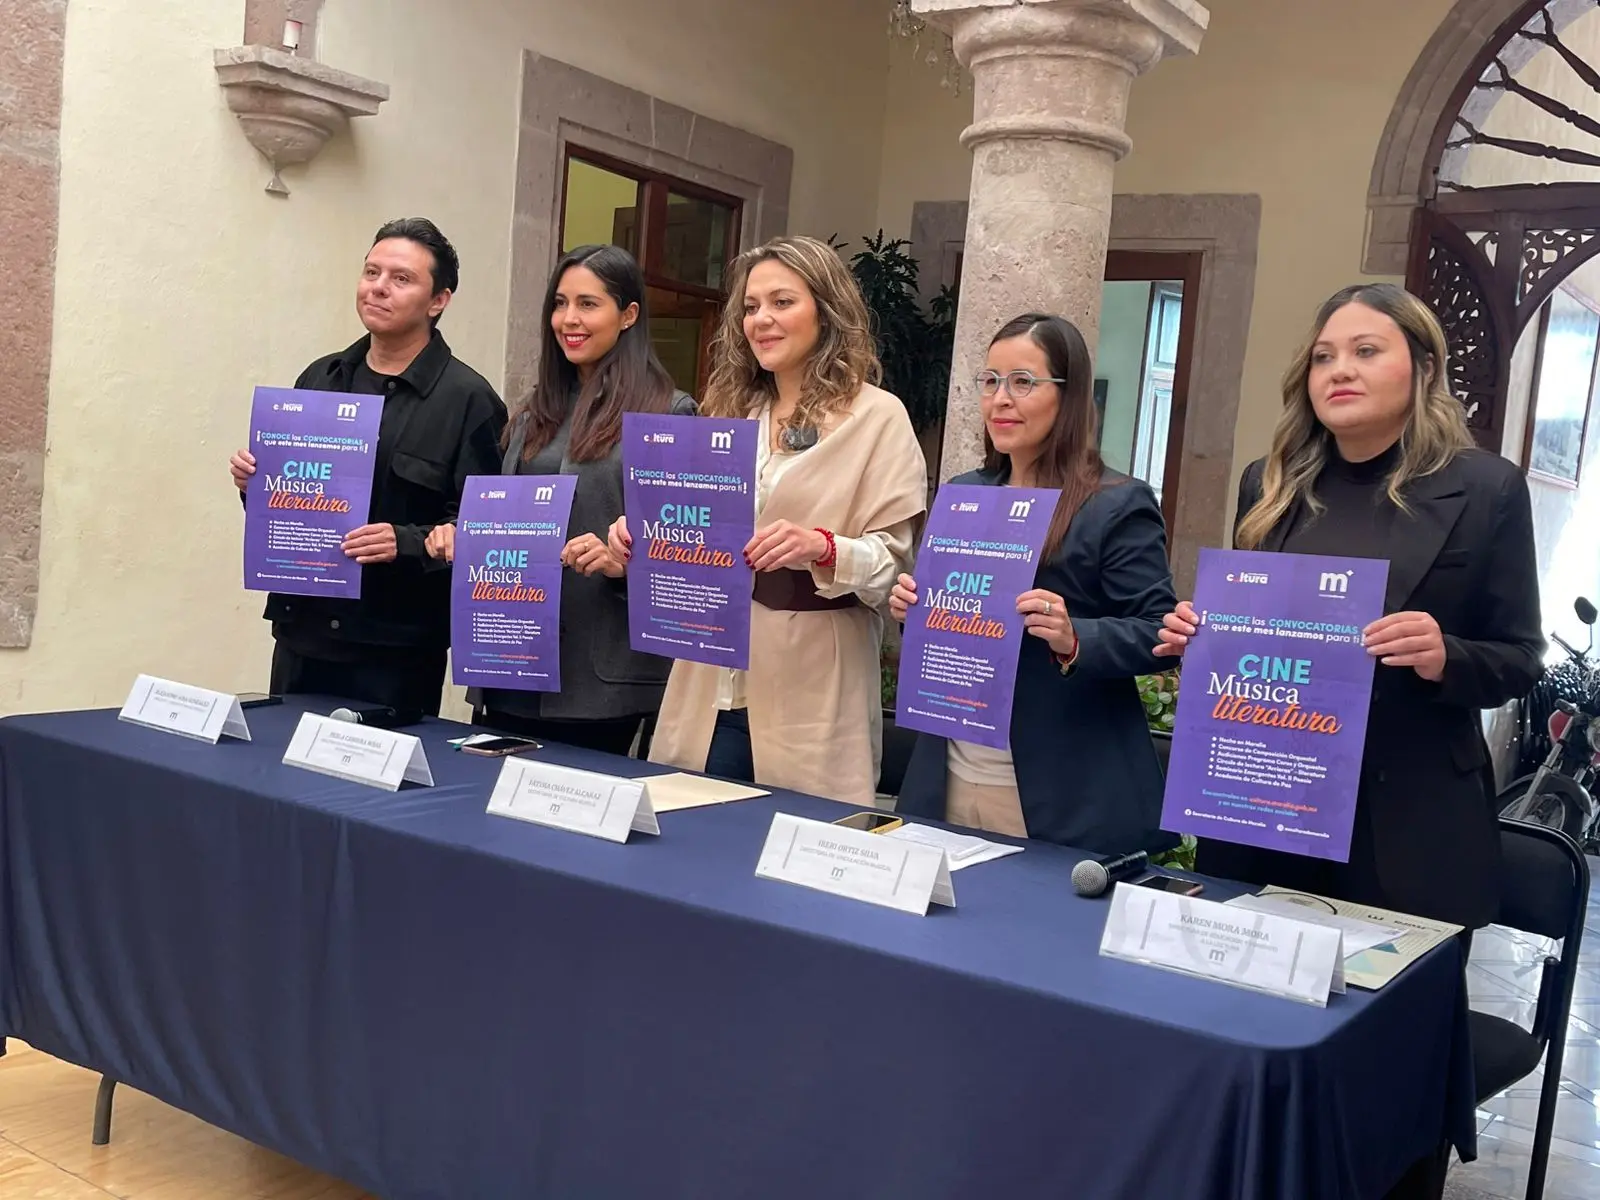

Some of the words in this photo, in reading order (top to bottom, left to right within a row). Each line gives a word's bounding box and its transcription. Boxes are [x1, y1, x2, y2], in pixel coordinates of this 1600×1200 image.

[263, 439, 276, 447] que
[308, 441, 340, 449] lanzamos
[342, 444, 357, 452] para
[303, 435, 363, 445] CONVOCATORIAS
[283, 460, 332, 480] CINE
[666, 471, 675, 479] las
[678, 472, 741, 483] CONVOCATORIAS
[264, 475, 324, 494] Música
[637, 478, 650, 487] que
[683, 480, 717, 490] lanzamos
[719, 484, 735, 493] para
[268, 491, 352, 513] literatura
[659, 503, 711, 528] CINE
[642, 520, 704, 544] Música
[648, 536, 736, 568] literatura
[933, 546, 945, 554] que
[959, 547, 973, 555] mes
[973, 548, 1005, 558] lanzamos
[1005, 552, 1021, 561] para
[971, 541, 1028, 552] CONVOCATORIAS
[485, 549, 528, 568] CINE
[468, 565, 522, 583] Música
[945, 571, 993, 596] CINE
[472, 580, 546, 602] literatura
[924, 588, 982, 613] Música
[926, 607, 1007, 639] literatura
[1211, 622, 1229, 633] que
[1231, 624, 1252, 633] este
[1253, 626, 1273, 635] mes
[1275, 627, 1323, 640] lanzamos
[1326, 633, 1350, 644] para
[1251, 616, 1265, 626] las
[1268, 618, 1358, 634] CONVOCATORIAS
[1238, 654, 1312, 684] CINE
[1207, 672, 1299, 704] Música
[1212, 693, 1342, 735] literatura
[837, 843, 860, 855] ORTIZ
[1179, 913, 1212, 928] KAREN
[1212, 920, 1241, 935] MORA
[1240, 927, 1270, 941] MORA
